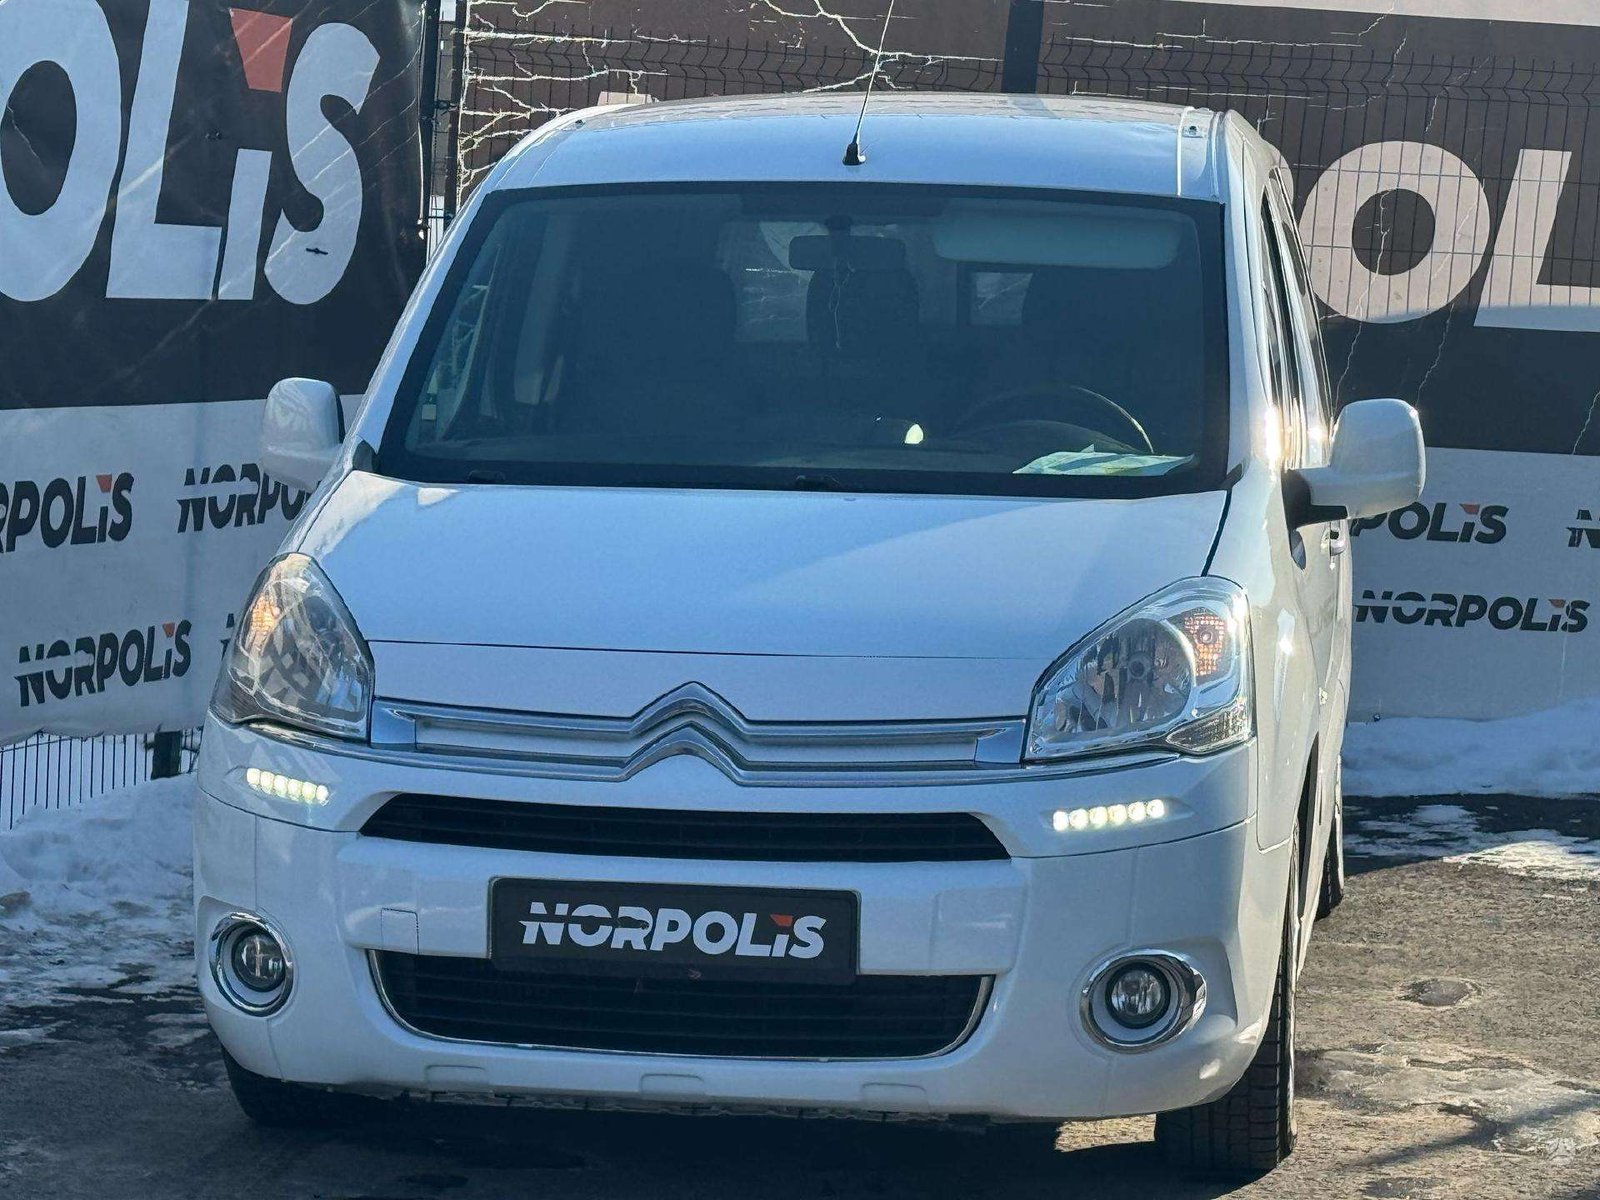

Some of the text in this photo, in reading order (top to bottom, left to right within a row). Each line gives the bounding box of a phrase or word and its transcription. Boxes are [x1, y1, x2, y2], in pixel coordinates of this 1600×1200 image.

[1278, 140, 1600, 332] OL
[178, 463, 319, 533] NORPO
[1352, 590, 1590, 633] NORPOLiS
[14, 619, 192, 707] NORPOLiS
[518, 902, 827, 959] NORPOLiS
